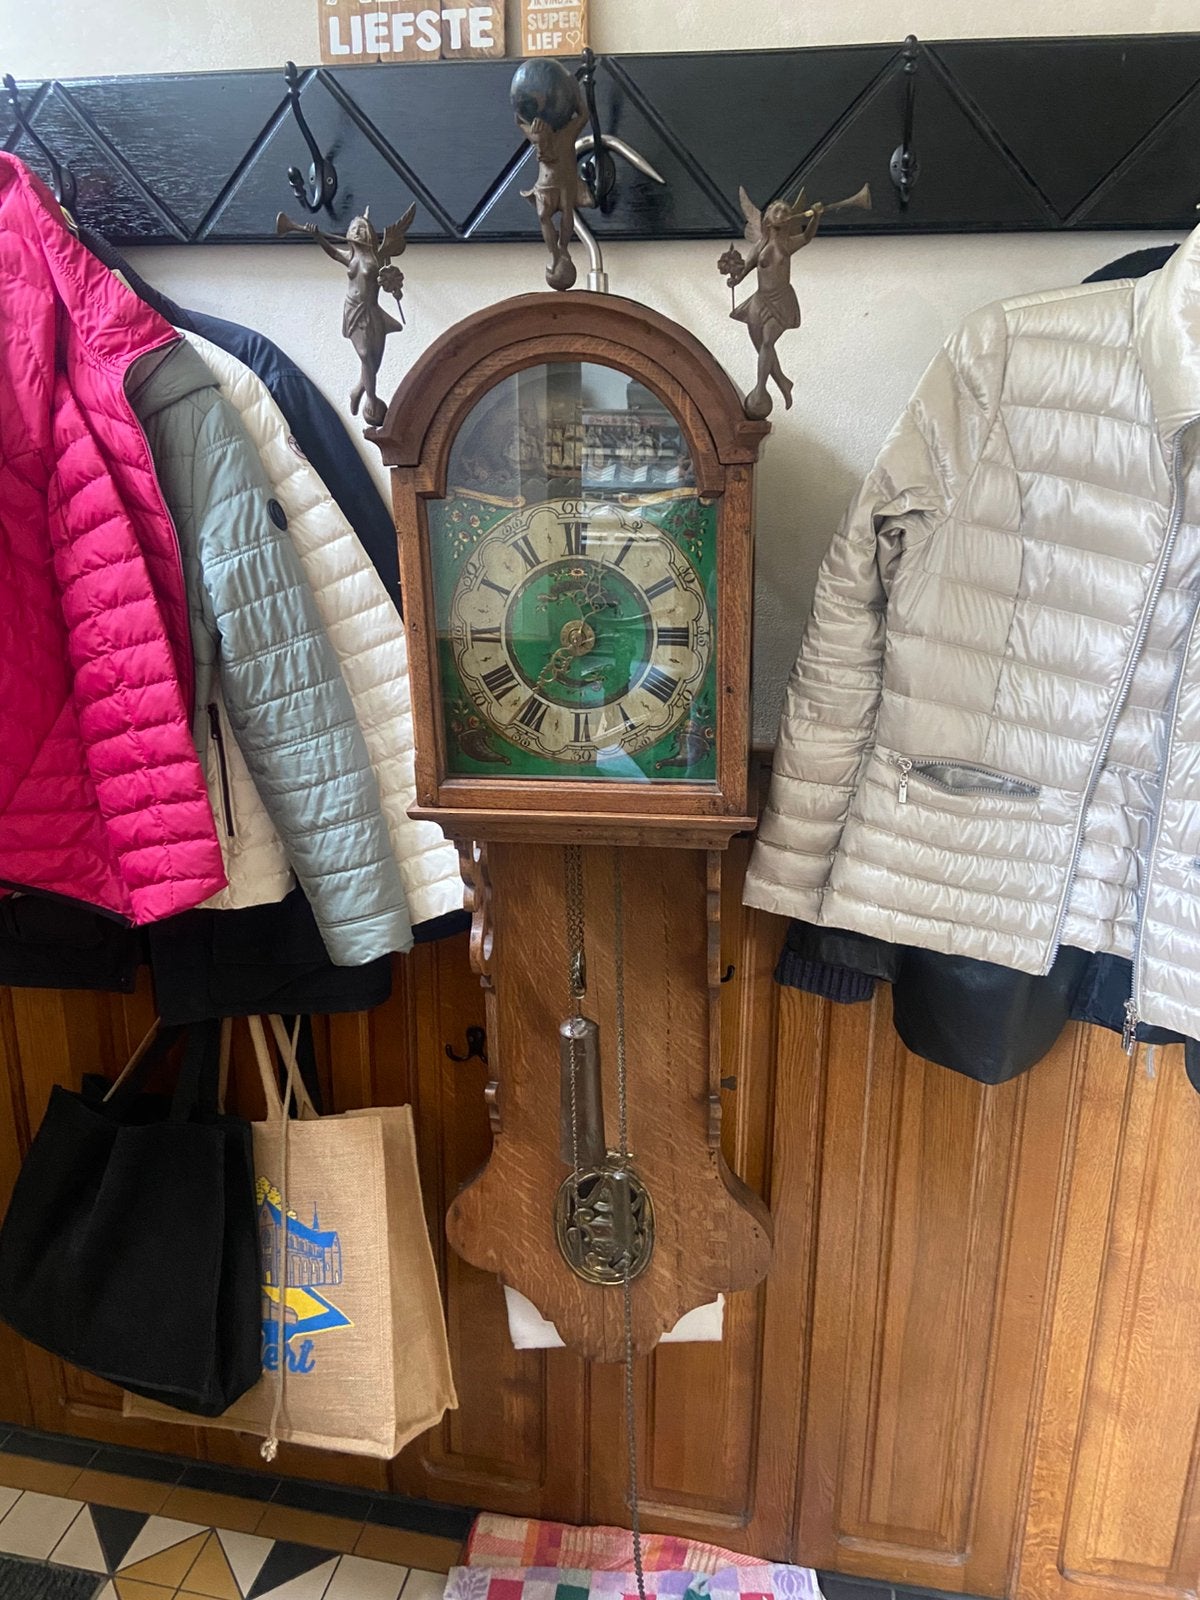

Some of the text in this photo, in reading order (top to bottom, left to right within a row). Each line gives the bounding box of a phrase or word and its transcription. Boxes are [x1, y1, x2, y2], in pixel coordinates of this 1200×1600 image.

[329, 7, 494, 55] LIEFSTE
[527, 11, 581, 31] SUPER
[527, 31, 562, 51] LIEF
[561, 500, 587, 514] 60
[507, 534, 547, 574] XI
[558, 522, 590, 556] XII
[638, 567, 680, 604] II
[655, 621, 690, 650] III
[480, 660, 521, 707] VIII
[638, 664, 682, 708] IIII
[514, 696, 551, 736] VII
[569, 711, 592, 742] VI
